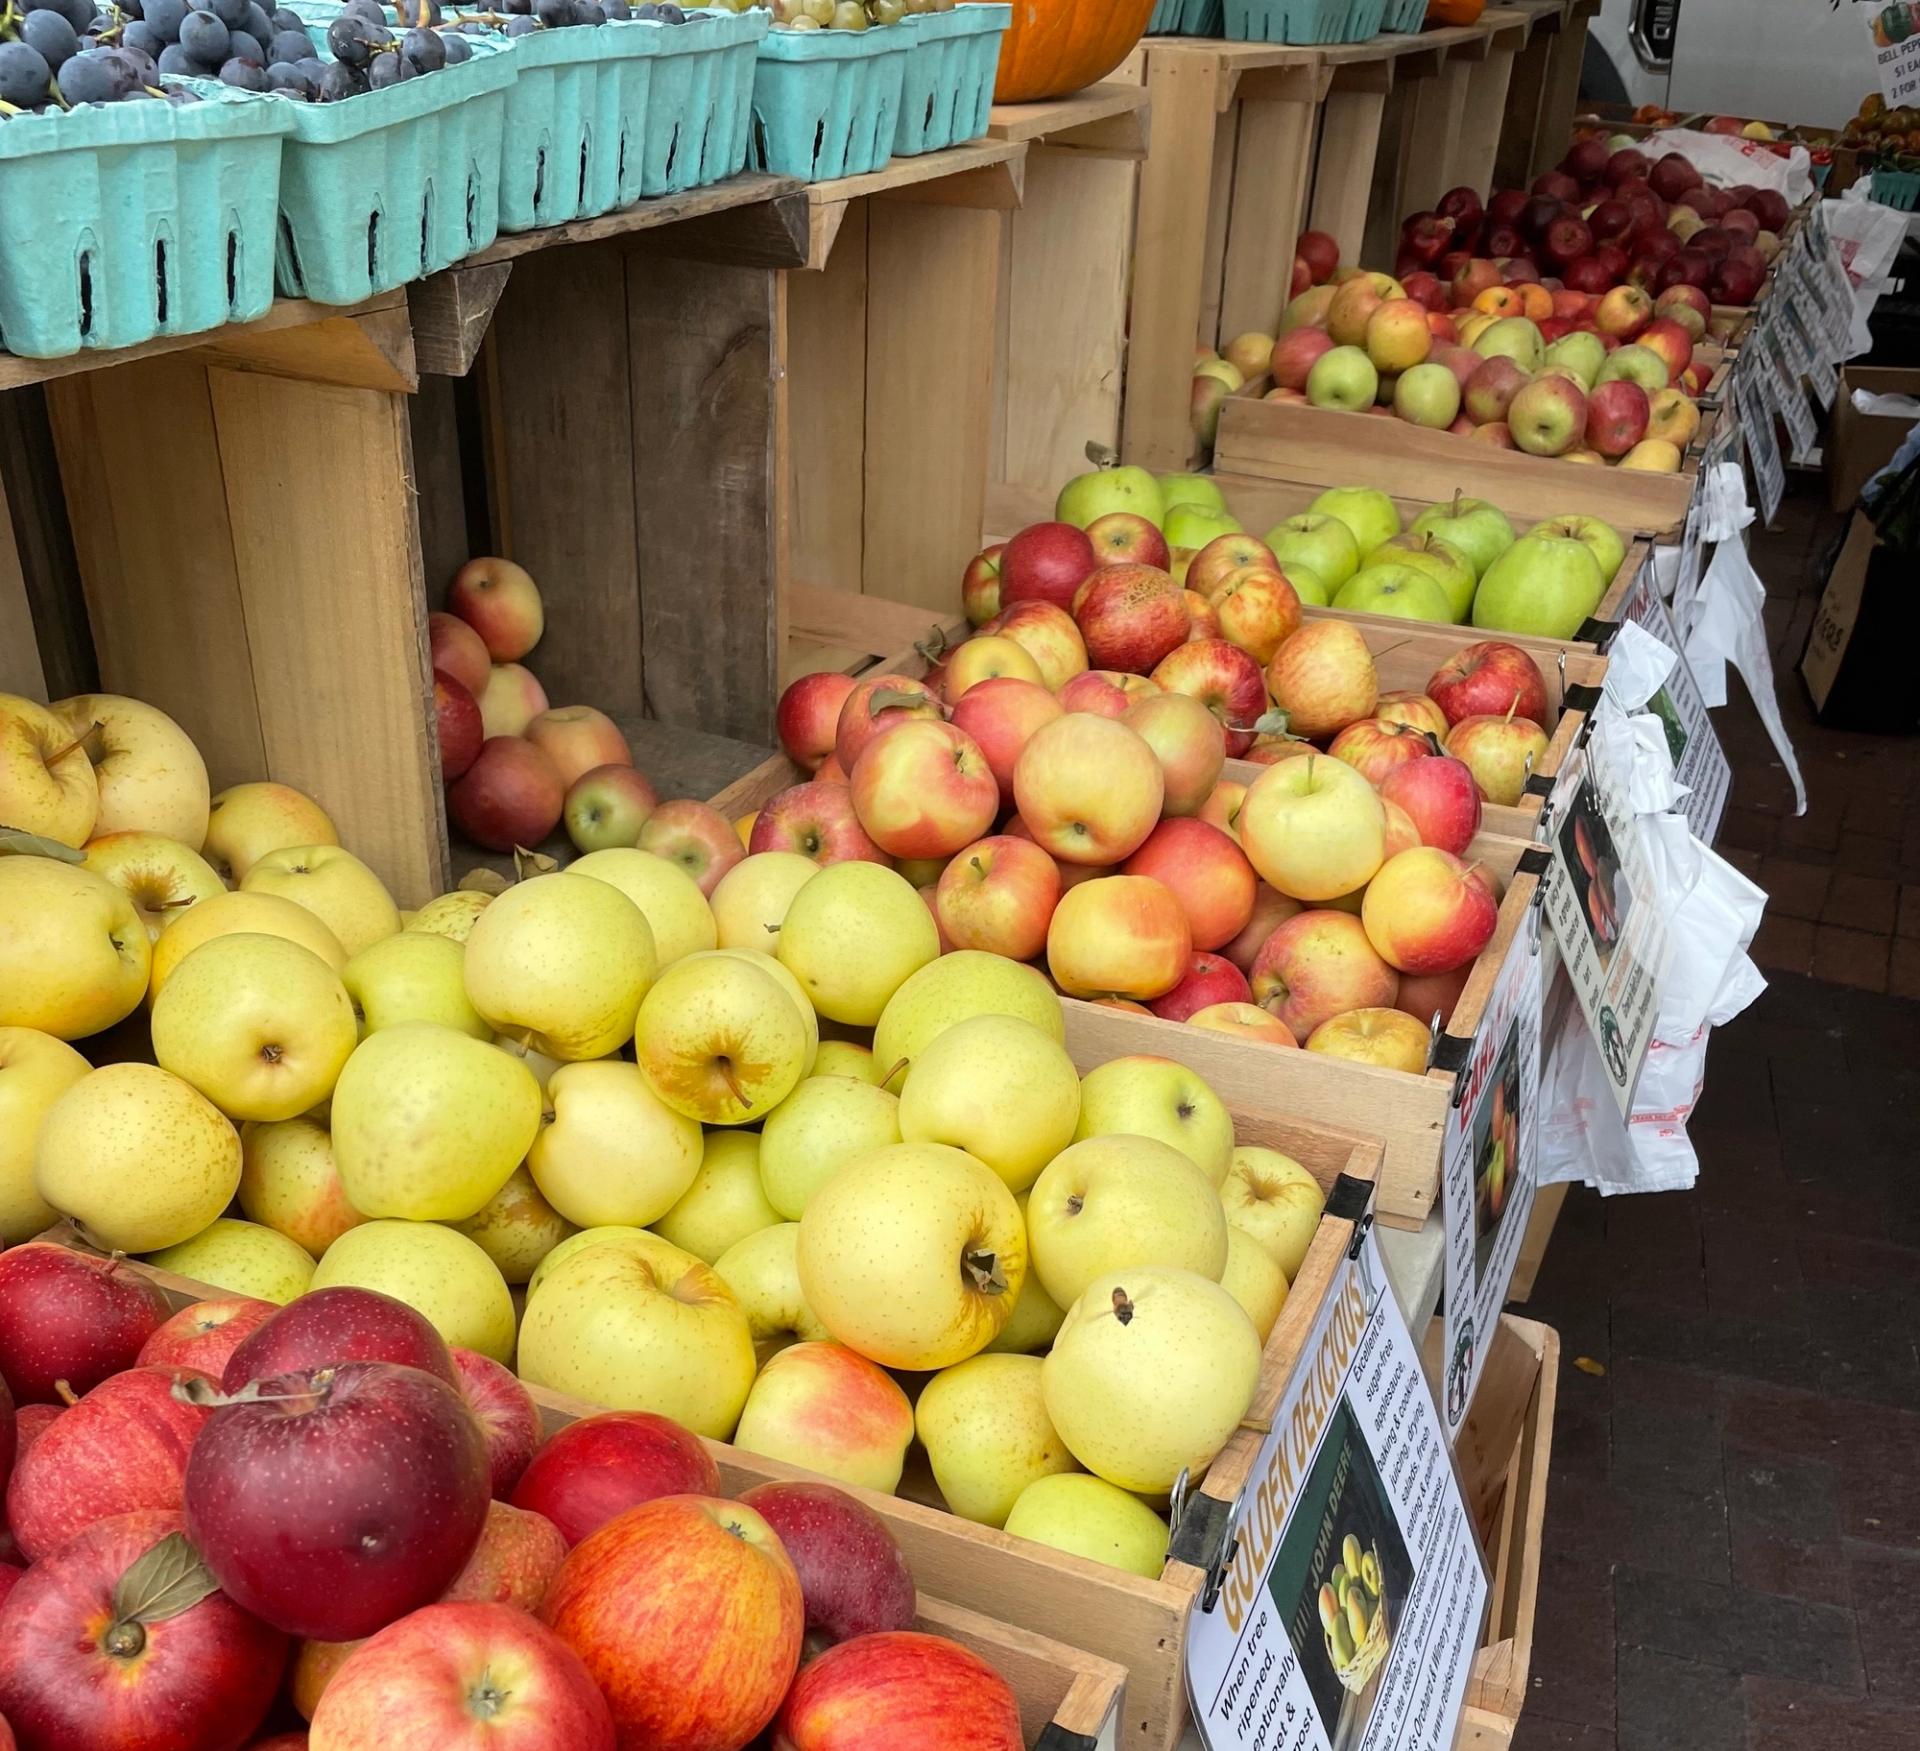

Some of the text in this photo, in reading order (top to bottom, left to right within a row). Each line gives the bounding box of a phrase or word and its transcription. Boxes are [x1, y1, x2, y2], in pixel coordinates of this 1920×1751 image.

[1877, 48, 1900, 65] BELL
[1450, 1140, 1471, 1196] Crunchy
[1456, 1176, 1467, 1212] and
[1454, 1200, 1470, 1248] sweet
[1456, 1237, 1468, 1271] with
[1352, 1308, 1385, 1383] Excellent for
[1366, 1338, 1393, 1402] sugar-free
[1374, 1361, 1405, 1431] applesauce,
[1376, 1369, 1419, 1472] baking & cooking,
[1224, 1266, 1367, 1635] GOLDEN DELICIOUS
[1388, 1400, 1424, 1493] juicing, drying,
[1401, 1426, 1429, 1505] salads, fresh
[1309, 1434, 1353, 1593] JOHN DEERE
[1406, 1440, 1439, 1538] eating & pairing
[1417, 1521, 1429, 1552] with
[1449, 1584, 1457, 1611] our
[1453, 1555, 1465, 1589] Farm
[1398, 1641, 1404, 1662] of
[1412, 1563, 1427, 1609] Golden
[1445, 1606, 1453, 1627] on
[1220, 1611, 1267, 1720] When tree
[1393, 1694, 1404, 1721] late
[1413, 1612, 1428, 1654] Parent
[1424, 1603, 1431, 1617] to
[1428, 1663, 1436, 1682] &
[1431, 1622, 1449, 1670] Winery
[1237, 1648, 1275, 1740] ripened,
[1285, 1701, 1295, 1722] &
[1413, 1674, 1433, 1737] Orchard
